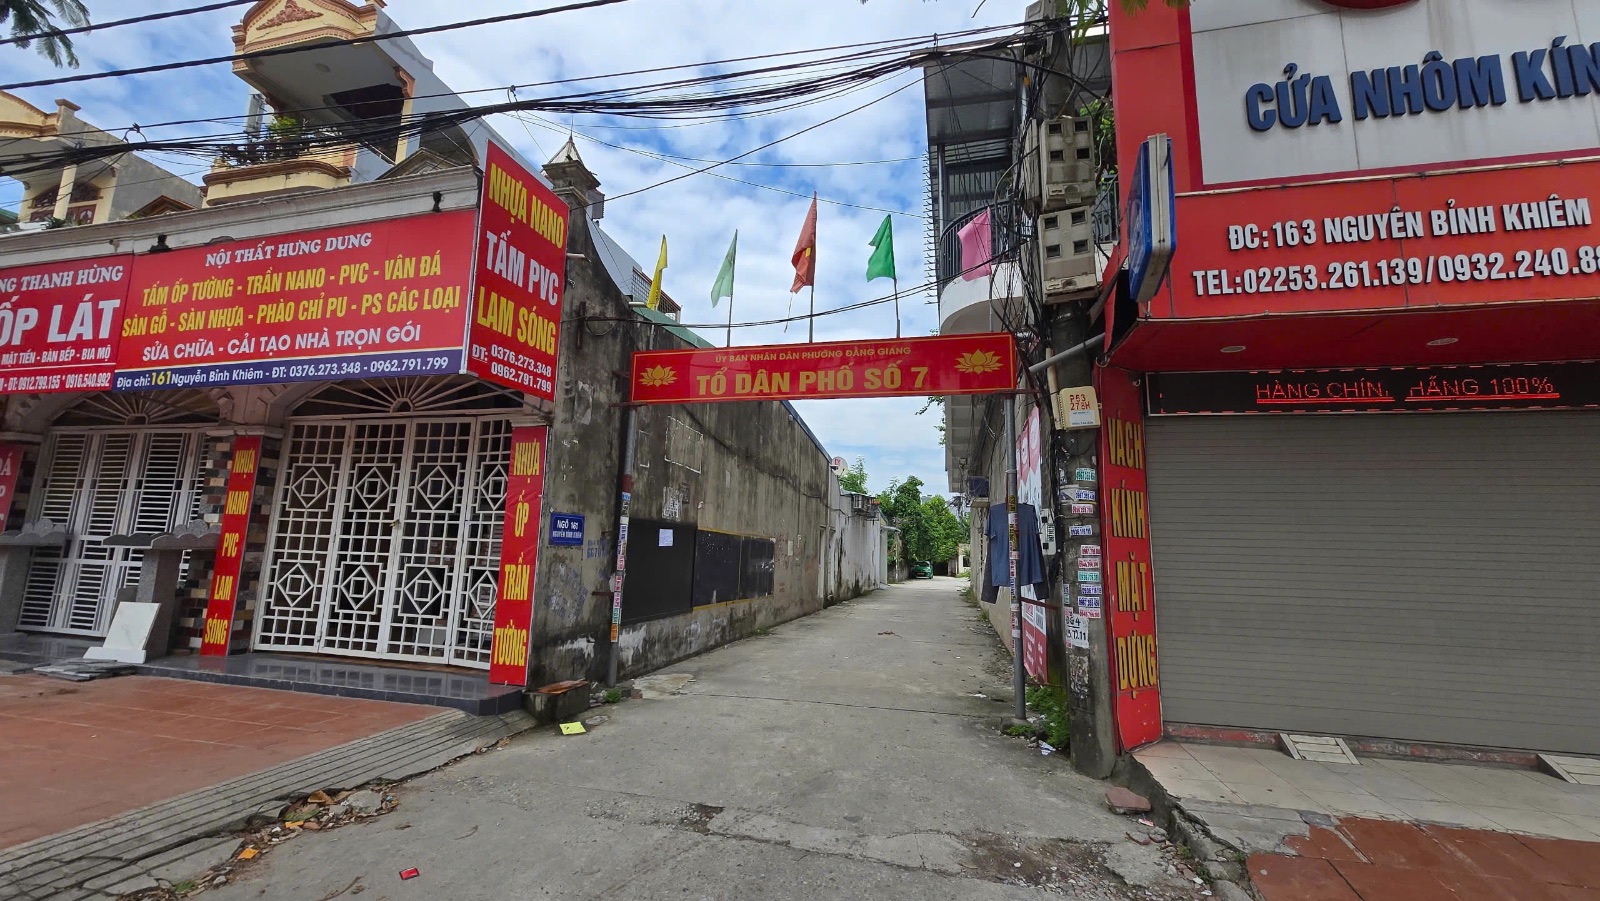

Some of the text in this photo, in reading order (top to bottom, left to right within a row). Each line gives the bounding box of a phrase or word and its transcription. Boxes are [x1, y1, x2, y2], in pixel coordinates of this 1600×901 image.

[1245, 62, 1342, 132] CỬA
[1349, 50, 1507, 121] NHÔM
[488, 162, 564, 249] NHỰA NANO
[1502, 193, 1592, 231] KHIÊM
[205, 232, 373, 268] NỘI THẤT HƯNG DUNG
[486, 229, 559, 306] TẤM PVC
[20, 270, 75, 292] THANH
[76, 263, 124, 286] HÙNG
[142, 250, 442, 307] TẤM ỐP TƯỜNG TRẦN NANO PVC VÂN ĐÁ
[47, 293, 121, 343] LÁT
[121, 286, 461, 337] SÀN GỖ SÀN NHỰA PHÀO CHỈ PU PS CÁC LOẠI
[477, 285, 557, 356] LAM SÓNG
[41, 348, 59, 363] BÀN
[59, 345, 75, 362] BẾP
[81, 347, 95, 361] BIA
[142, 320, 421, 362] SỬA CHỮA CẢI TẠO NHÀ TRỌN GÓI
[472, 343, 552, 378] ĐT: 0376.273.348
[730, 352, 749, 363] BAN
[751, 351, 777, 362] NHÂN
[779, 351, 800, 361] DÂN
[877, 346, 912, 357] GIANG
[116, 375, 131, 391] Địa
[150, 371, 171, 386] 161
[171, 369, 207, 387] Nguyễn
[232, 367, 264, 381] Khiêm
[271, 364, 288, 379] ĐT:
[290, 362, 361, 378] 0376.273.348
[370, 357, 449, 373] 0962.791.799
[490, 361, 552, 394] 0962.791.799
[696, 359, 928, 396] TỔ DÂN PHỐ SỐ 7
[1256, 379, 1320, 399] HÀNG
[1490, 376, 1555, 396] 100%
[1107, 410, 1143, 469] VÁCH
[232, 447, 256, 479] NHỰA
[513, 438, 541, 484] NHỰA
[225, 490, 250, 515] NANO
[514, 489, 530, 538] ỐP
[1110, 479, 1146, 539] KÍNH
[221, 532, 240, 558] PVC
[213, 574, 234, 601] LAM
[1116, 551, 1147, 622] MẶT
[204, 612, 229, 646] SÓNG
[493, 618, 528, 667] TƯỜNG
[1116, 630, 1157, 699] DỰNG
